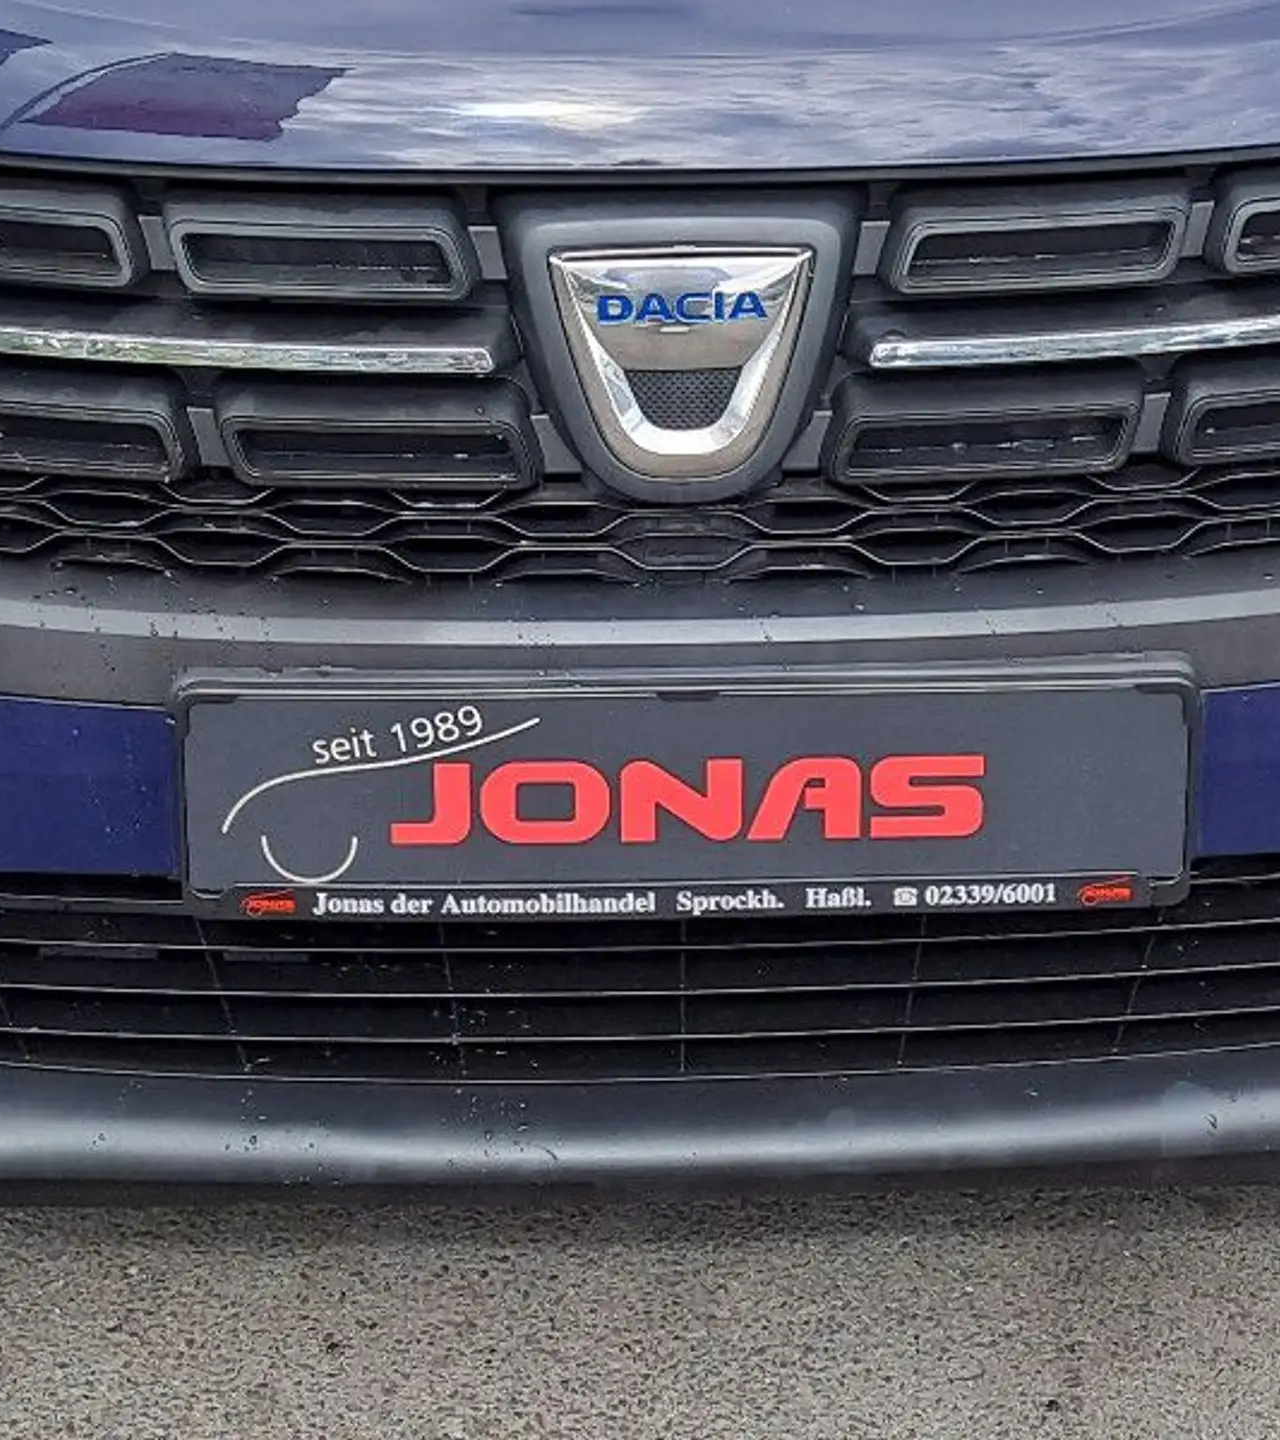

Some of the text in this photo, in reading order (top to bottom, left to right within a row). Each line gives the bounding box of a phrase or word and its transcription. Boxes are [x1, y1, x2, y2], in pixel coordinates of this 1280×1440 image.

[596, 291, 768, 324] DACIA
[312, 704, 484, 765] seit 1989
[389, 754, 986, 845] JONAS
[313, 892, 384, 915] Jonas
[390, 891, 434, 915] der
[440, 891, 657, 915] Automobilhandel
[675, 889, 786, 914] Sprockh.
[805, 886, 873, 909] Haßl.
[925, 882, 1058, 906] 02339/6001
